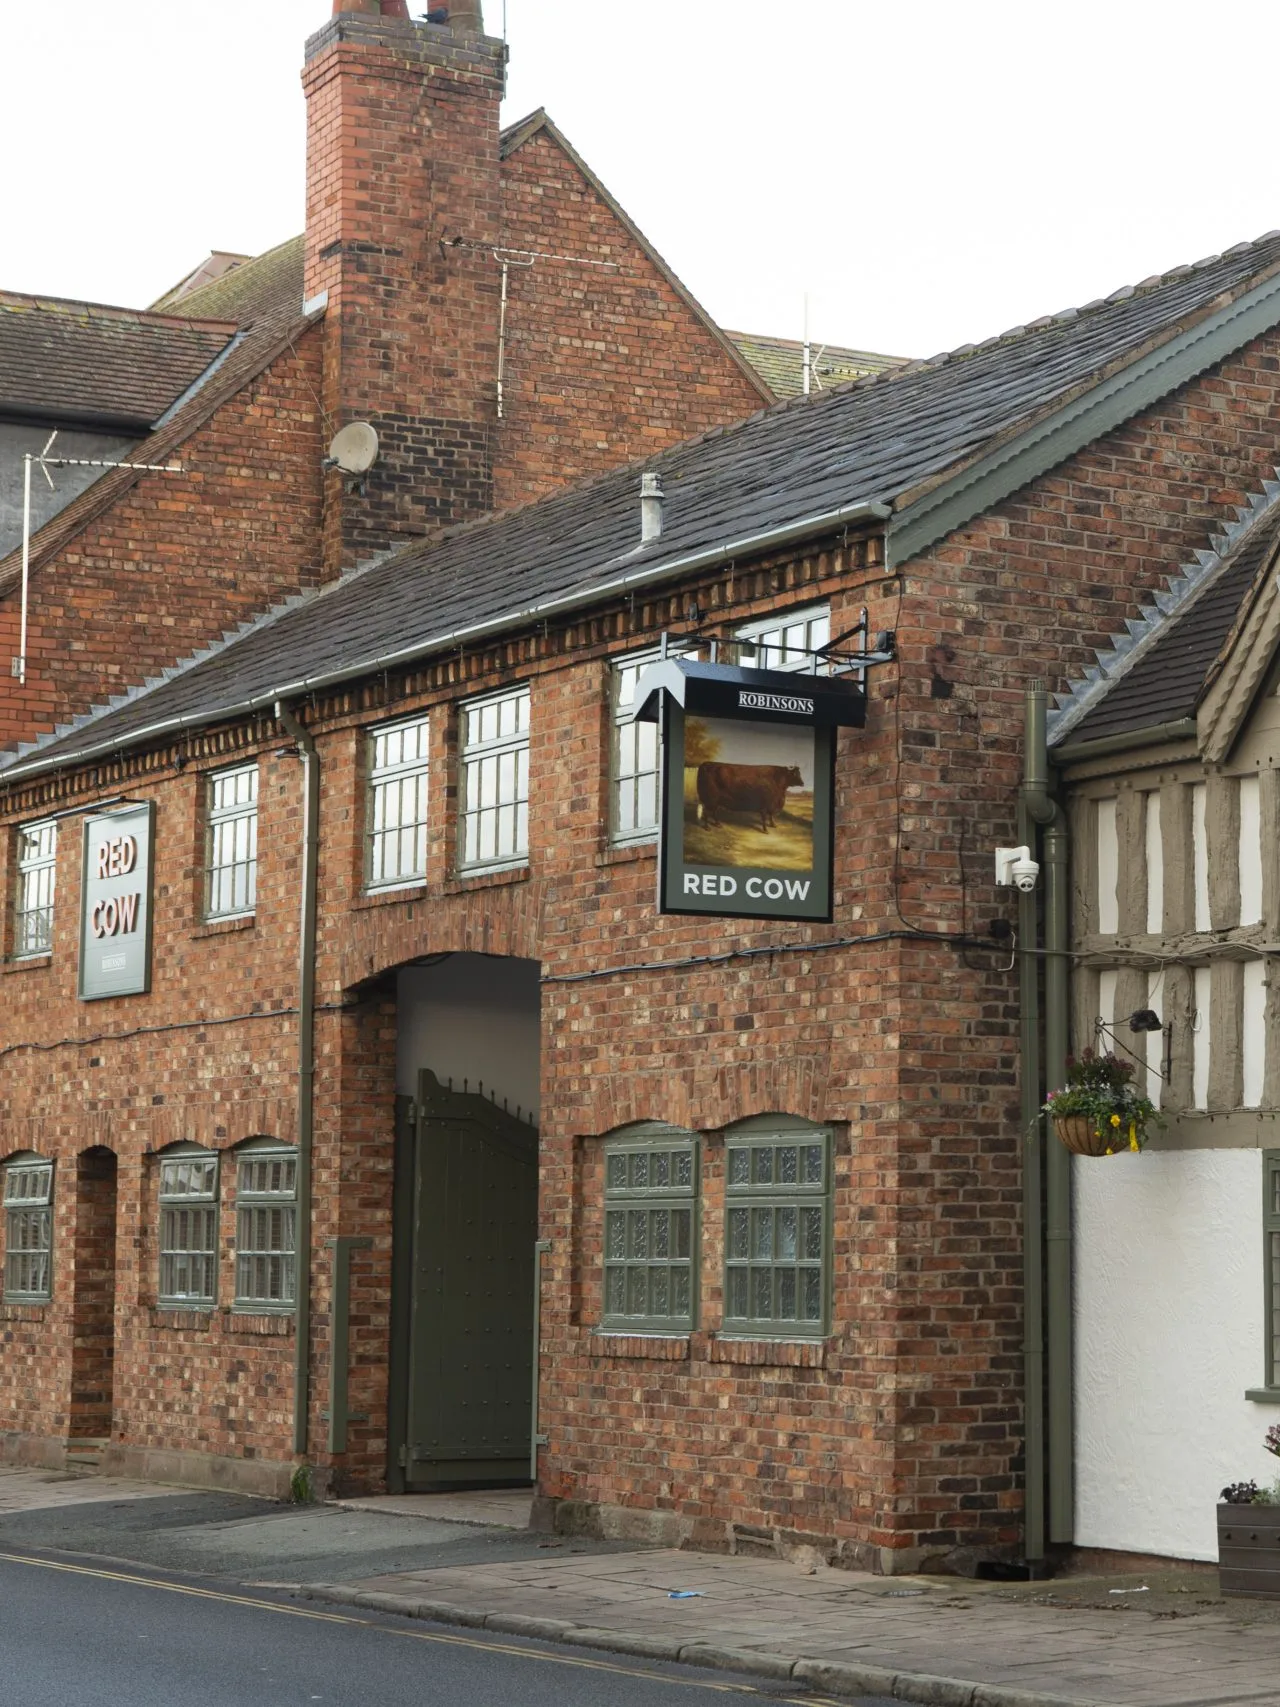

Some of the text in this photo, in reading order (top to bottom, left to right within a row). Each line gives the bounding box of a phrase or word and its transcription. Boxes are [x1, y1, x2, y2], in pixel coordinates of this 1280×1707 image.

[738, 692, 815, 713] ROBINSONS
[97, 834, 138, 880] RED
[683, 873, 811, 901] RED COW
[93, 893, 140, 938] COW
